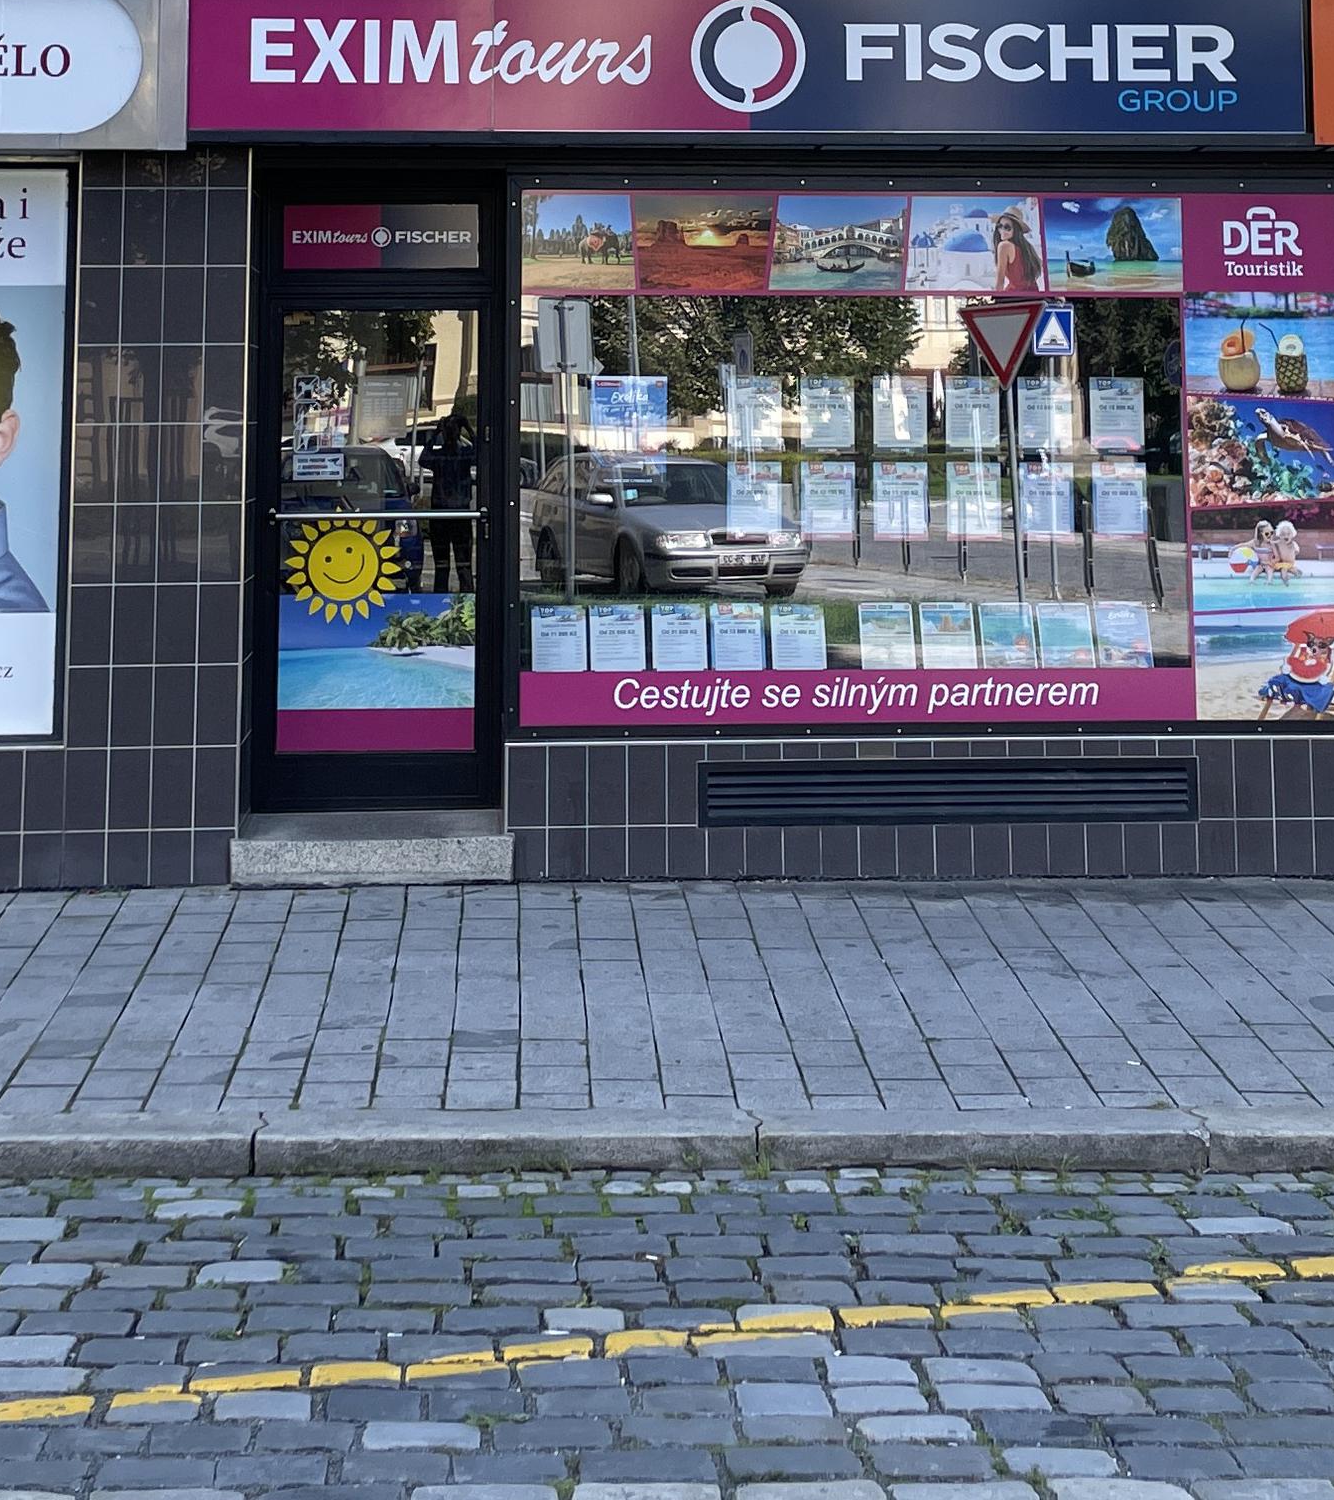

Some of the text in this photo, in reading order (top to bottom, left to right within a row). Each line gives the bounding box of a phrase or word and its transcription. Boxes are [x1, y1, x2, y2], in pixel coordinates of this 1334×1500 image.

[843, 21, 1237, 83] FISCHER
[1117, 88, 1238, 113] GROUP
[19, 188, 30, 220] i
[394, 230, 471, 244] FISCHER
[1224, 260, 1304, 278] Touristik
[613, 677, 1100, 716] Cestujte se silným partnerem
